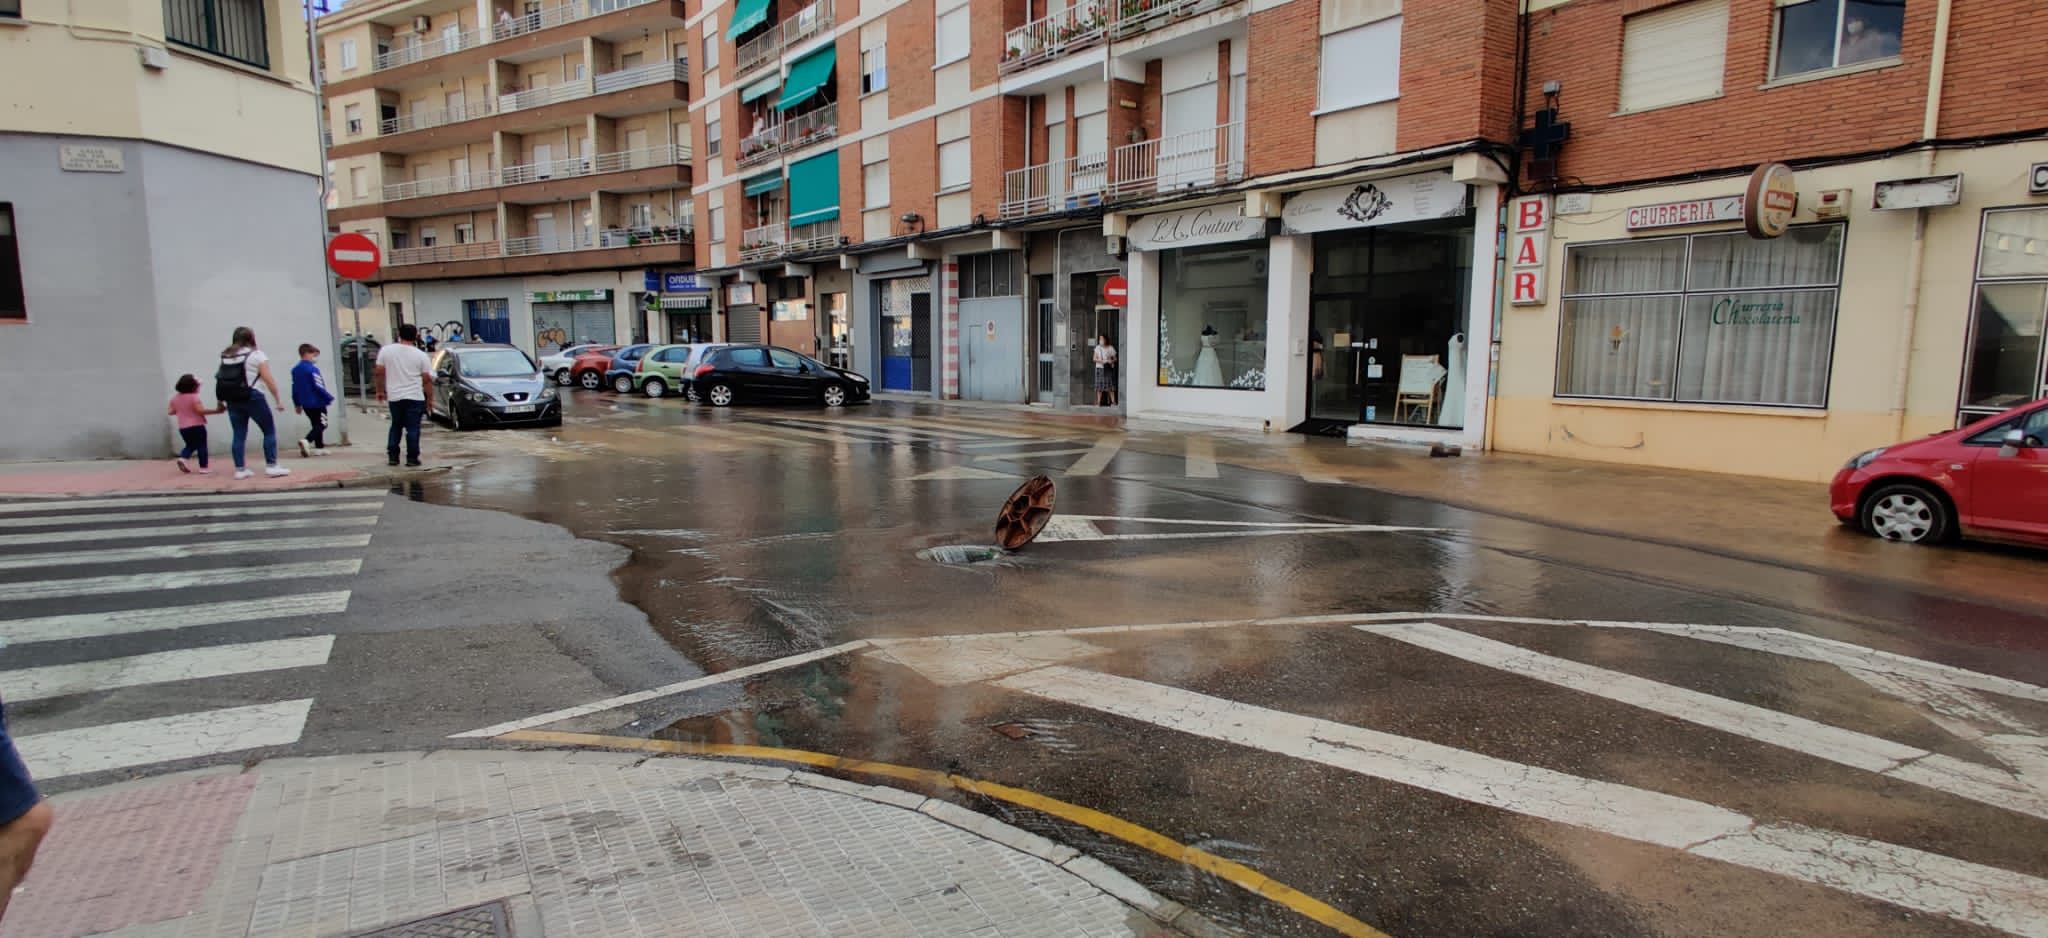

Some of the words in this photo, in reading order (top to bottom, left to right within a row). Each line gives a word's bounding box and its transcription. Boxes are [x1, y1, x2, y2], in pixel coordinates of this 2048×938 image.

[1190, 208, 1244, 237] Couture
[1630, 201, 1715, 227] CHURRERIA
[1515, 199, 1544, 301] BAR
